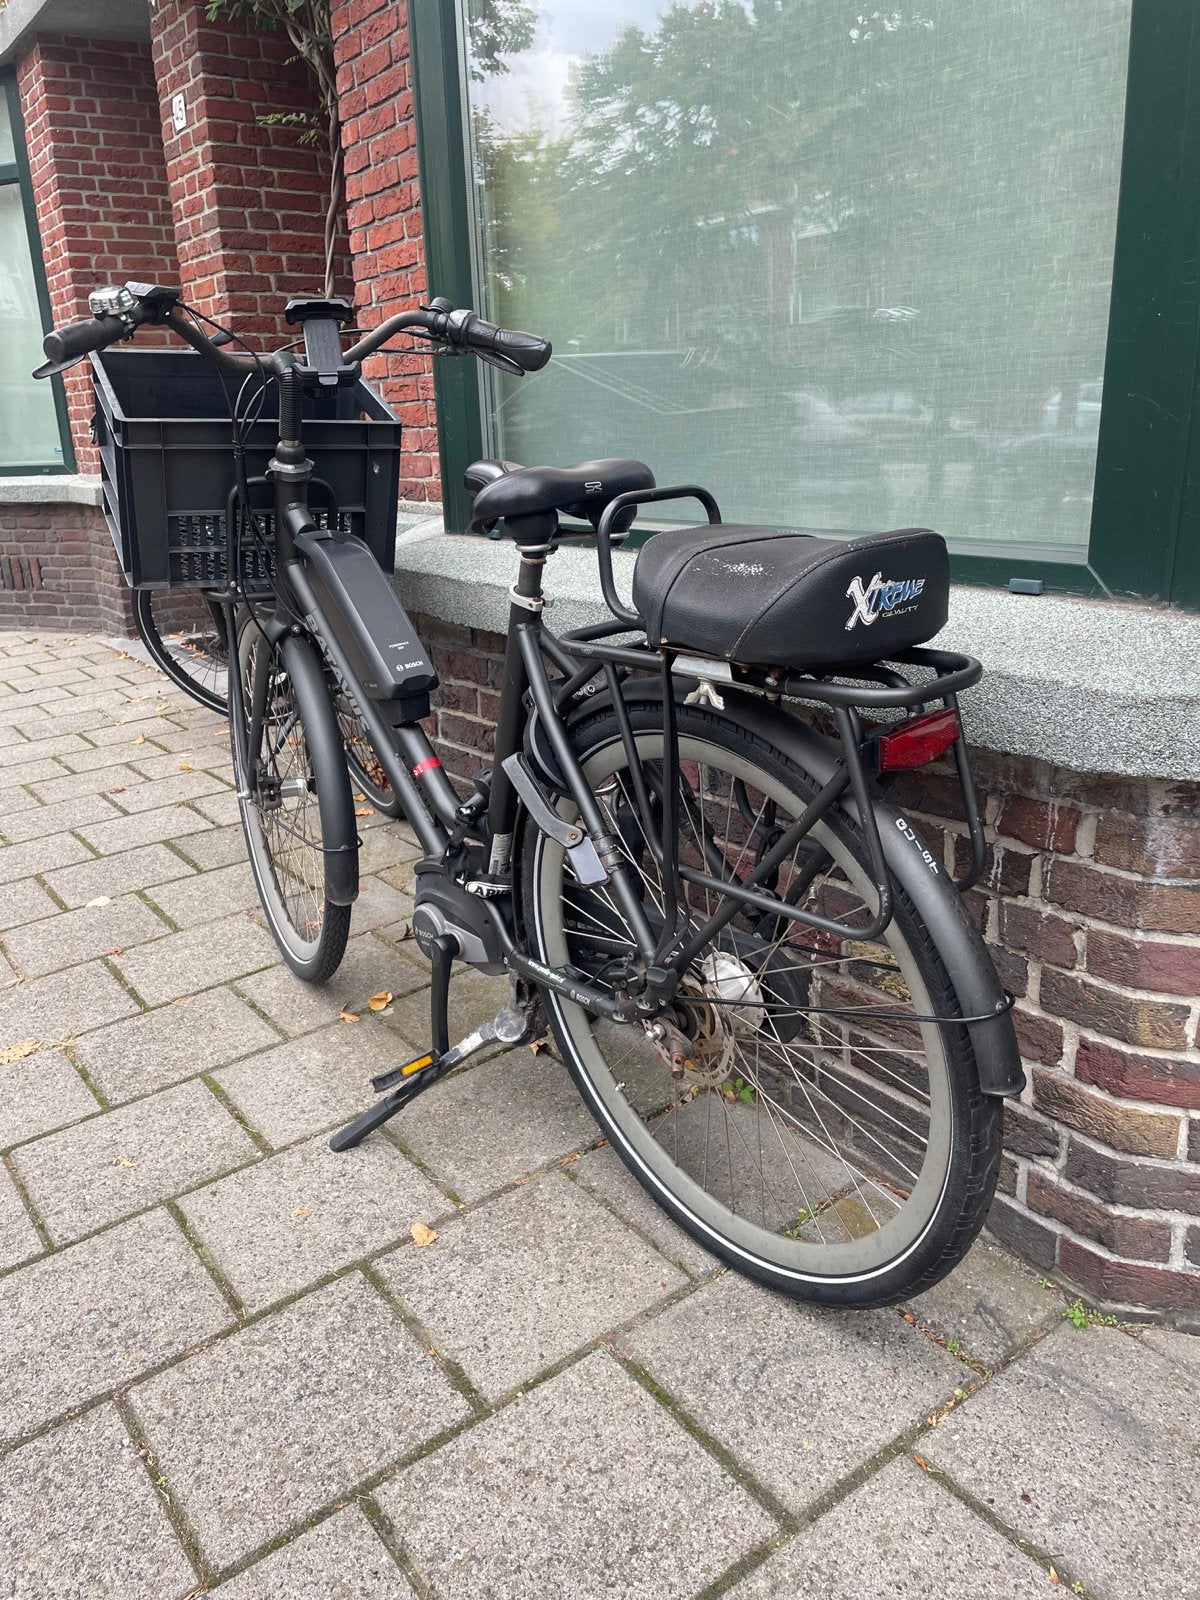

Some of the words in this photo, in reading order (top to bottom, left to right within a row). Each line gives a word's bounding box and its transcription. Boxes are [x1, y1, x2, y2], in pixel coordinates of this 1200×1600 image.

[305, 613, 371, 733] BATAVUS
[404, 660, 424, 669] BOSCH
[895, 817, 939, 874] QUIST
[576, 993, 591, 1006] BOSCH
